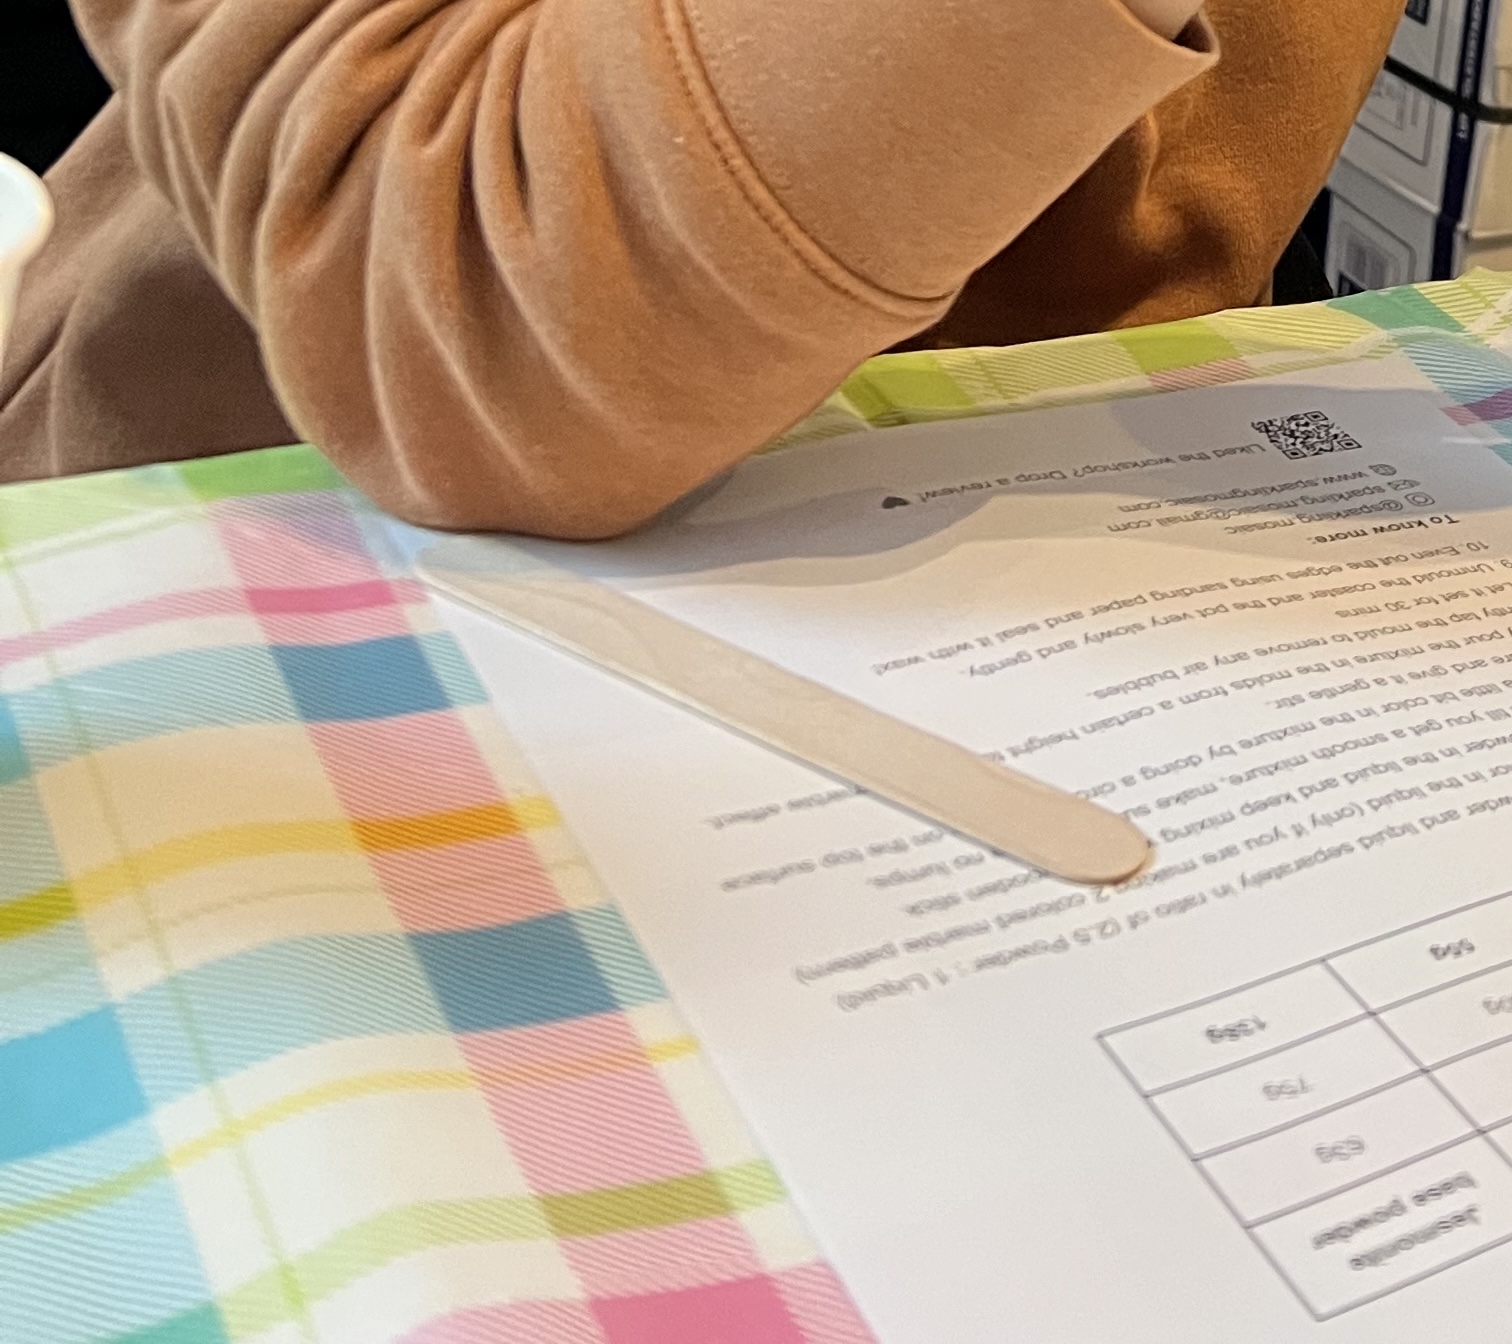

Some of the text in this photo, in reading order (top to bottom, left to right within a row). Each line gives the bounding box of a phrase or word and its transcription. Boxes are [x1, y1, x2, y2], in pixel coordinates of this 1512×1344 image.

[1176, 451, 1211, 462] the
[1211, 443, 1266, 458] Liked
[1069, 455, 1175, 477] workshop?
[1013, 468, 1067, 483] Drop
[1306, 514, 1459, 545] To know more:
[1376, 553, 1409, 566] out
[1409, 545, 1460, 560] Even
[1284, 563, 1343, 579] edges
[1345, 559, 1379, 570] the
[1411, 563, 1494, 583] Unmould
[1228, 572, 1284, 587] using
[1378, 576, 1412, 588] the
[1148, 580, 1228, 602] sanding
[1308, 582, 1377, 599] coaster
[1438, 589, 1470, 602] set
[1469, 587, 1486, 596] it
[1087, 593, 1147, 615] paper
[1231, 599, 1267, 612] the
[1266, 593, 1305, 607] and
[1383, 600, 1411, 612] 30
[1411, 595, 1439, 606] for
[1148, 610, 1193, 626] very
[1194, 603, 1230, 618] pot
[1333, 604, 1382, 619] mins
[1446, 610, 1482, 623] tap
[1043, 610, 1085, 629] and
[1415, 617, 1449, 629] the
[995, 622, 1041, 642] seal
[1081, 620, 1146, 645] slowly
[1330, 633, 1353, 643] to
[1353, 623, 1413, 640] mould
[1460, 629, 1505, 644] pour
[973, 635, 994, 648] it
[1034, 639, 1078, 659] and
[1253, 637, 1328, 656] remove
[1426, 639, 1461, 651] the
[926, 641, 973, 660] with
[1211, 650, 1250, 666] any
[1352, 645, 1425, 664] mixture
[1180, 661, 1210, 676] air
[1295, 662, 1331, 676] the
[1329, 658, 1353, 669] in
[1405, 663, 1450, 680] give
[1450, 658, 1489, 673] and
[1229, 669, 1293, 691] molds
[1388, 673, 1407, 684] it
[1177, 685, 1229, 706] from
[1306, 677, 1371, 700] gentle
[1429, 690, 1460, 704] bit
[1458, 682, 1503, 697] little
[1355, 707, 1380, 719] in
[1380, 696, 1429, 714] color
[1081, 705, 1156, 735] certain
[1319, 712, 1357, 727] the
[1443, 710, 1484, 727] you
[1484, 707, 1511, 721] till
[1237, 721, 1318, 750] mixture
[1406, 718, 1444, 736] get
[1005, 727, 1079, 758] height
[1205, 742, 1237, 760] by
[1311, 733, 1390, 760] smooth
[1401, 751, 1440, 767] the
[1437, 746, 1462, 758] in
[1138, 752, 1203, 781] doing
[1341, 759, 1402, 784] liquid
[1425, 776, 1464, 793] the
[1462, 771, 1488, 783] in
[1154, 782, 1219, 810] make
[1297, 777, 1340, 799] and
[1238, 790, 1297, 817] keep
[1364, 784, 1427, 811] liquid
[1307, 801, 1365, 828] (only
[1418, 809, 1462, 830] and
[1159, 809, 1237, 843] mixing
[1241, 825, 1286, 849] you
[1355, 821, 1420, 849] liquid
[1201, 843, 1240, 864] are
